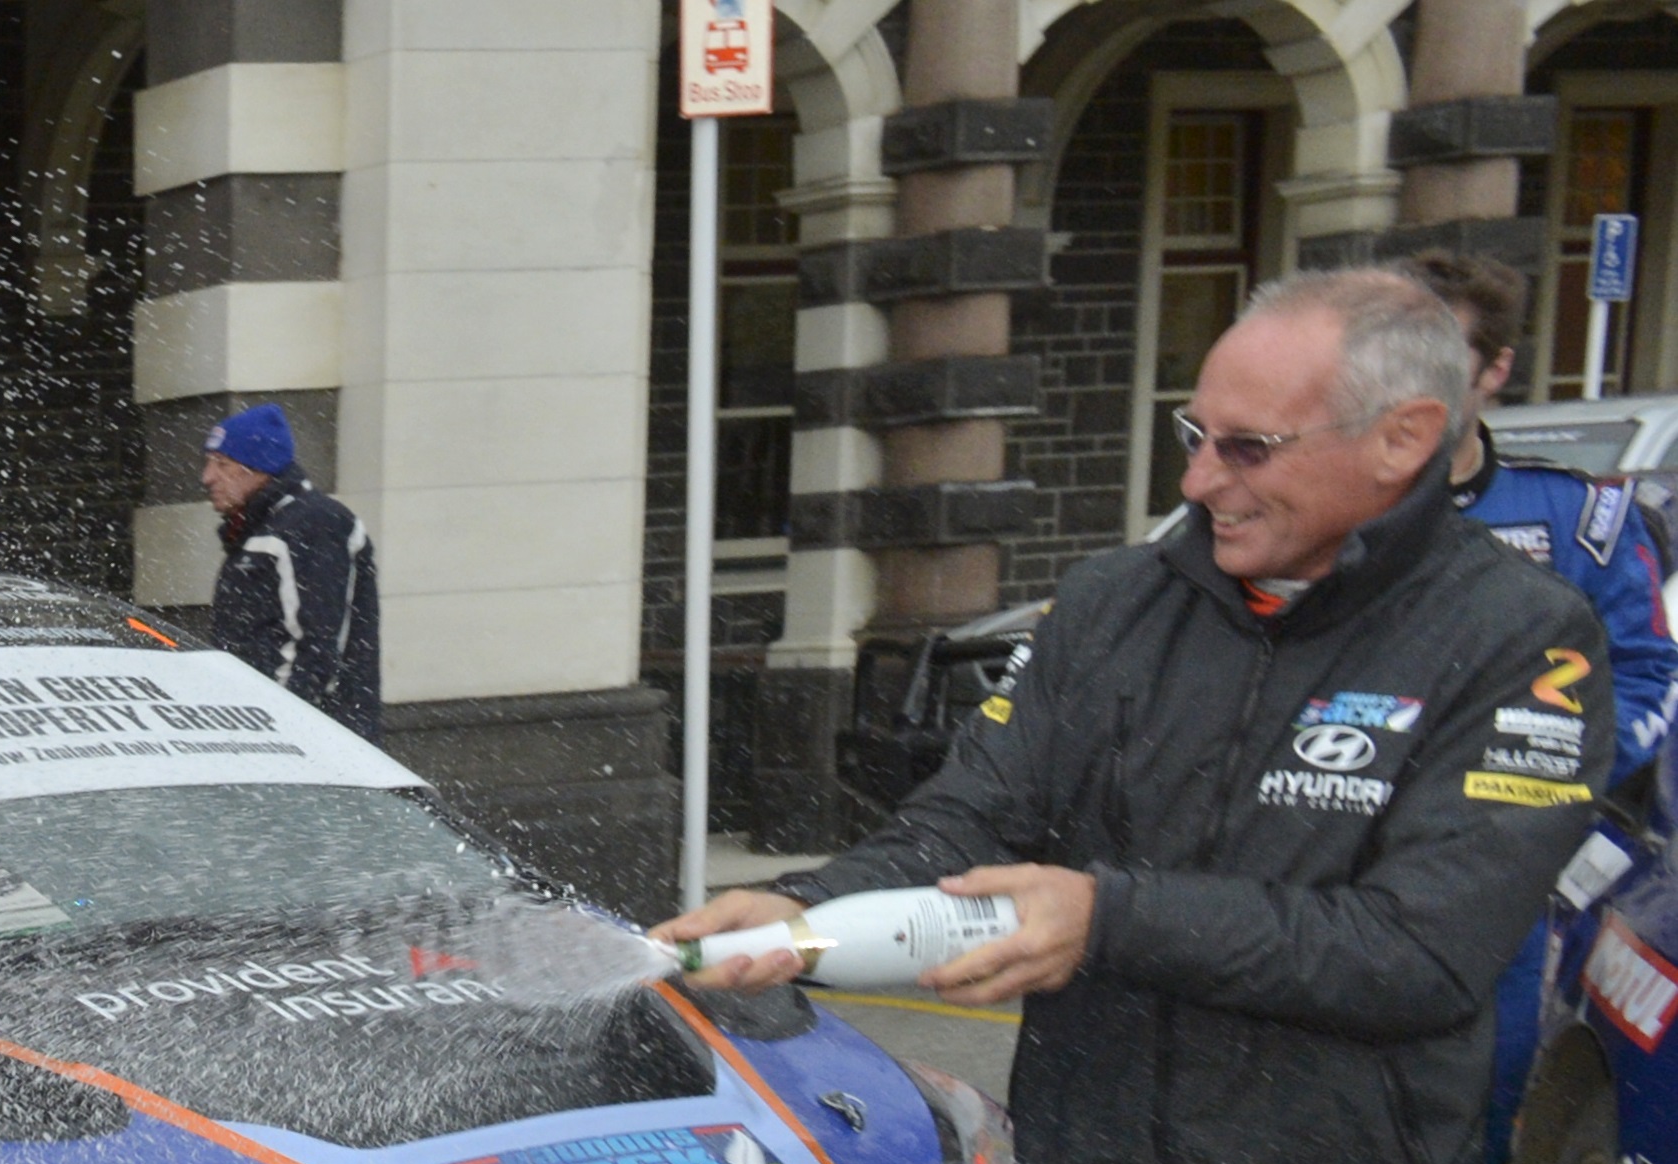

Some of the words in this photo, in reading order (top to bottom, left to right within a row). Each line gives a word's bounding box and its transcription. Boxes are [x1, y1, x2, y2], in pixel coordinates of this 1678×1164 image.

[37, 675, 174, 703] GREEN
[154, 703, 279, 733] GROUP
[35, 745, 114, 763] Zealand
[1260, 770, 1394, 806] HYUNDAI
[77, 953, 394, 1021] provident
[253, 977, 505, 1022] insuran
